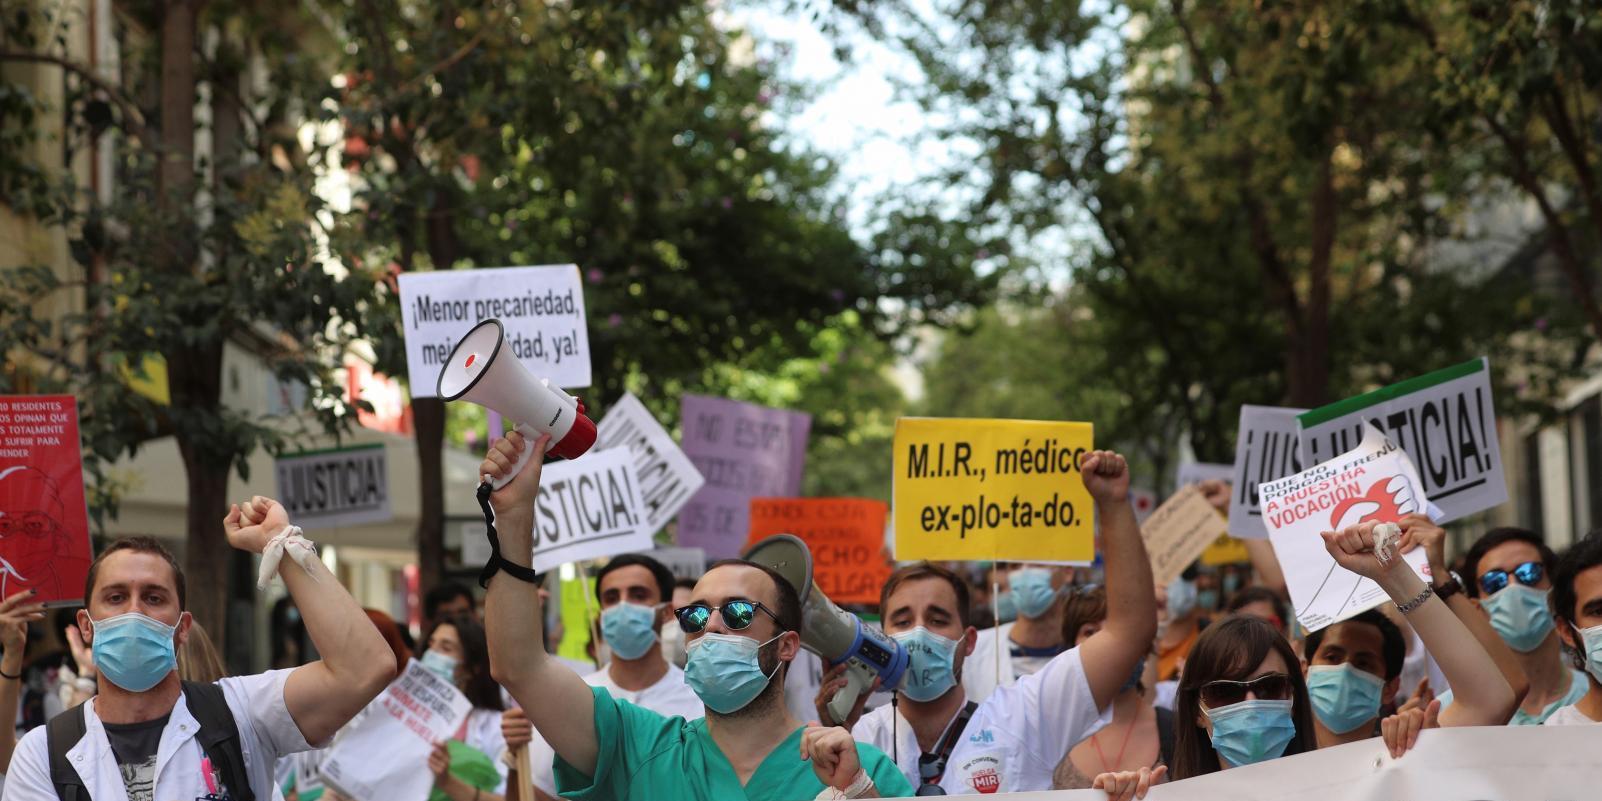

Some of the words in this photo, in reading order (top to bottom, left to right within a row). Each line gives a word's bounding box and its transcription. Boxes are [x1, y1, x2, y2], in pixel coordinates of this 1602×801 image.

[412, 295, 470, 329] ¡Menor
[475, 288, 580, 322] precariedad,
[422, 337, 456, 366] mej
[506, 331, 549, 363] idad,
[552, 329, 578, 364] ya!
[12, 402, 62, 412] RESIDENTES
[14, 413, 46, 423] OPINAN
[50, 413, 68, 423] QUE
[5, 437, 33, 446] SUFRIR
[37, 436, 61, 446] PARA
[9, 425, 65, 435] TOTALMENTE
[1312, 387, 1492, 492] TICIA!
[907, 441, 986, 483] M.I.R.,
[996, 438, 1087, 475] médico
[1263, 478, 1298, 494] QUE
[1303, 465, 1328, 479] NO
[279, 455, 386, 511] ¡JUSTICIA!
[1264, 470, 1337, 502] PONGAN
[1267, 501, 1280, 513] A
[1283, 466, 1367, 506] NUESTRA
[534, 465, 640, 547] STICIA!
[920, 492, 1081, 539] ex-plo-ta-do.
[1270, 481, 1362, 529] VOCACIÓN
[975, 775, 997, 788] MIR
